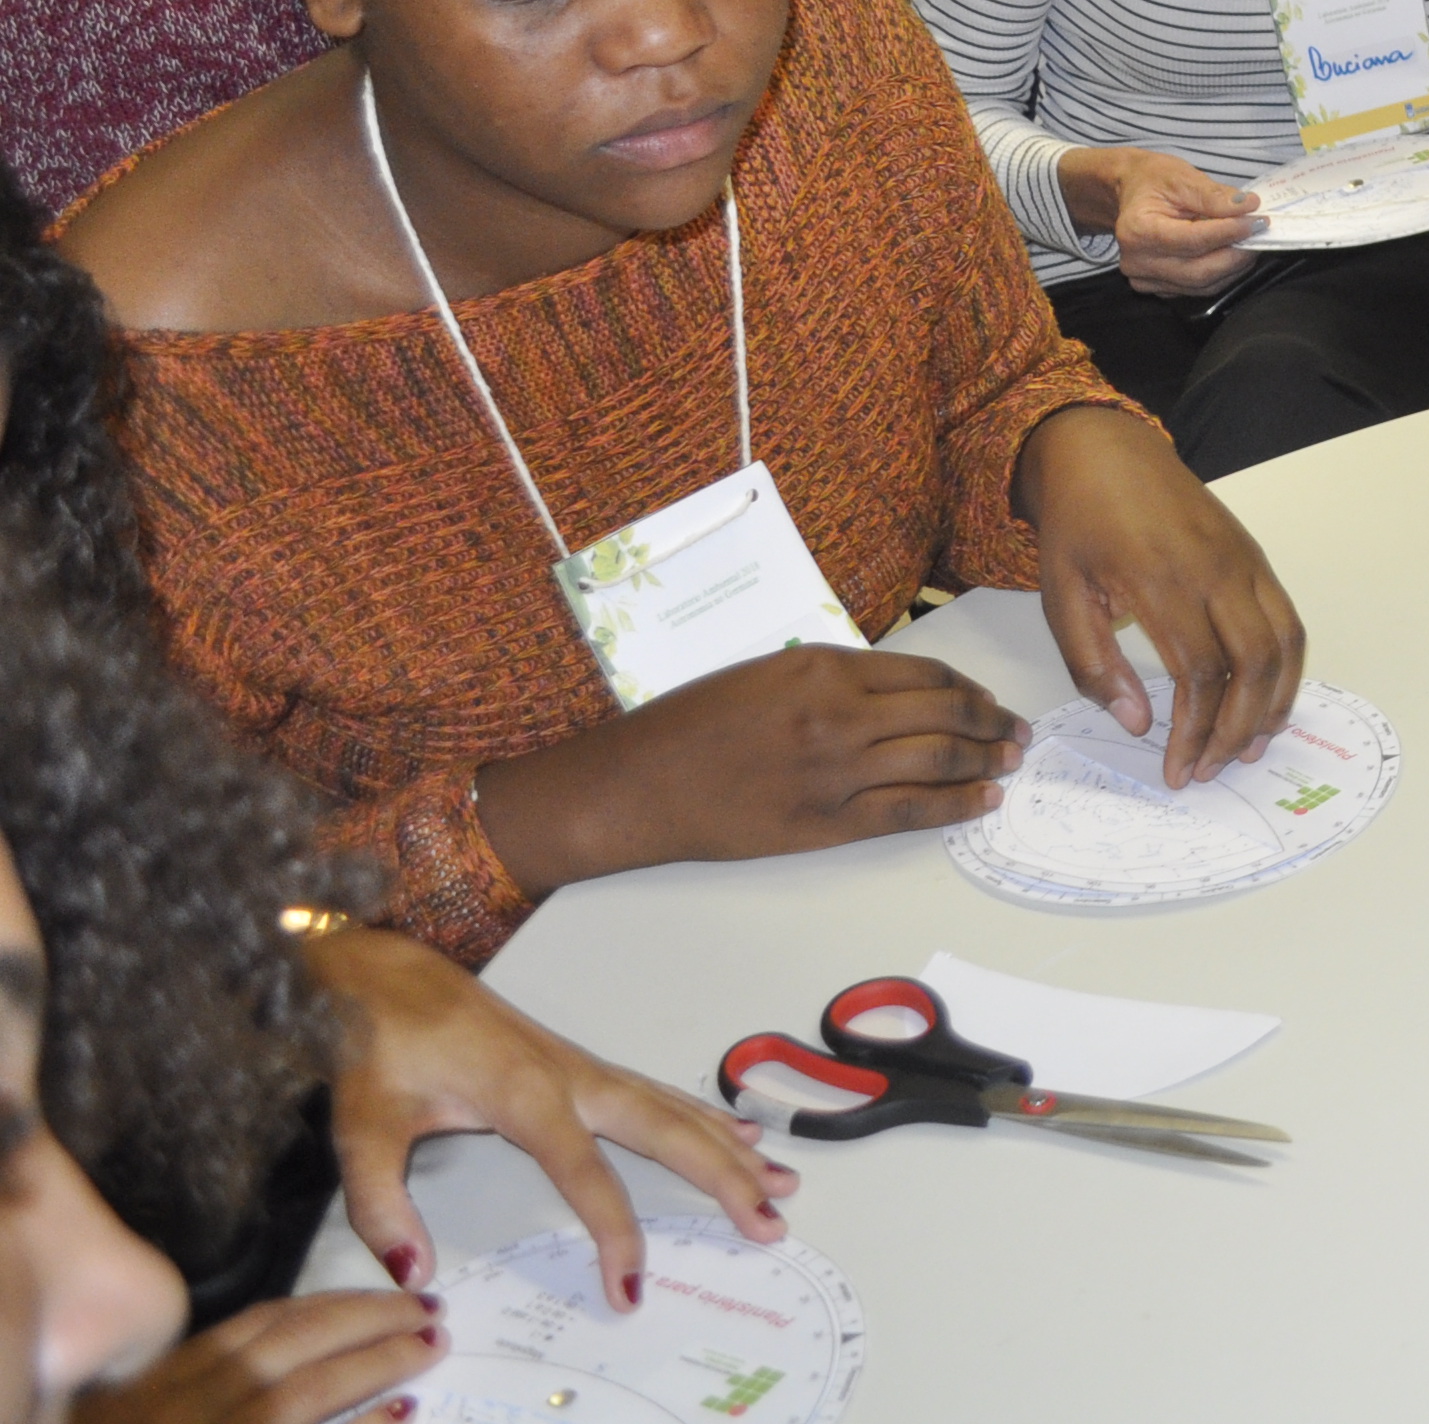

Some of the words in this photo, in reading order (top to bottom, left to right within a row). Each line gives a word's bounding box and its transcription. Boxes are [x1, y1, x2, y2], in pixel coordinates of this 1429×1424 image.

[1307, 45, 1414, 82] Luciana
[1290, 726, 1359, 763] Planisfério
[697, 1287, 796, 1331] Planisfério
